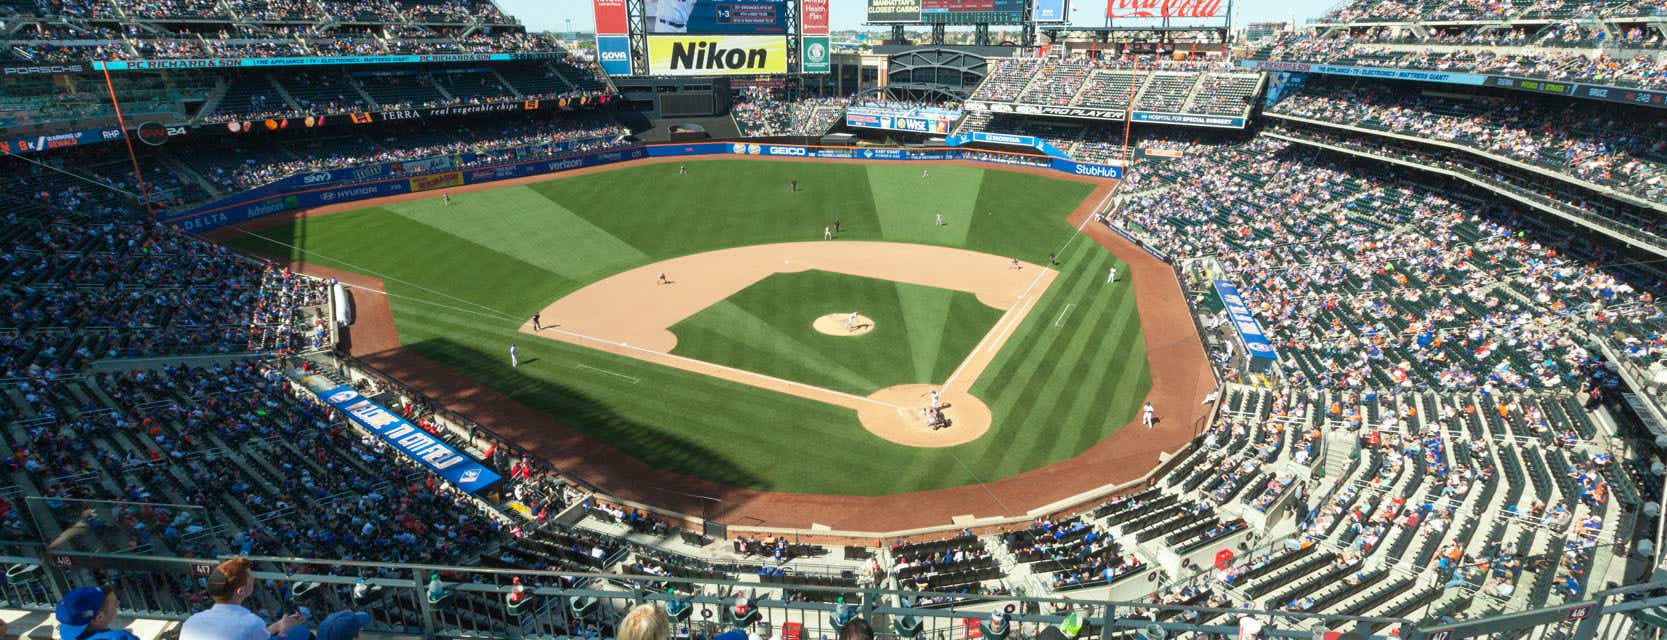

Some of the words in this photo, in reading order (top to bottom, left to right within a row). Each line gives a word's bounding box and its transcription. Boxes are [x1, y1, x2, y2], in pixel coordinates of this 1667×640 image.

[602, 51, 627, 60] GOYA
[670, 41, 768, 70] Nikon
[4, 65, 82, 75] PORSCHE
[381, 110, 420, 121] TERRA
[431, 107, 449, 115] real
[452, 104, 494, 115] vegetable
[496, 103, 518, 112] chips
[1041, 106, 1069, 116] PRO
[1071, 109, 1125, 119] PLAYER
[167, 127, 186, 136] 24
[770, 147, 806, 156] GEICO
[549, 159, 583, 171] verizon
[1075, 164, 1117, 178] StubHub
[336, 186, 378, 199] HYUNDAI
[183, 212, 228, 231] DELTA
